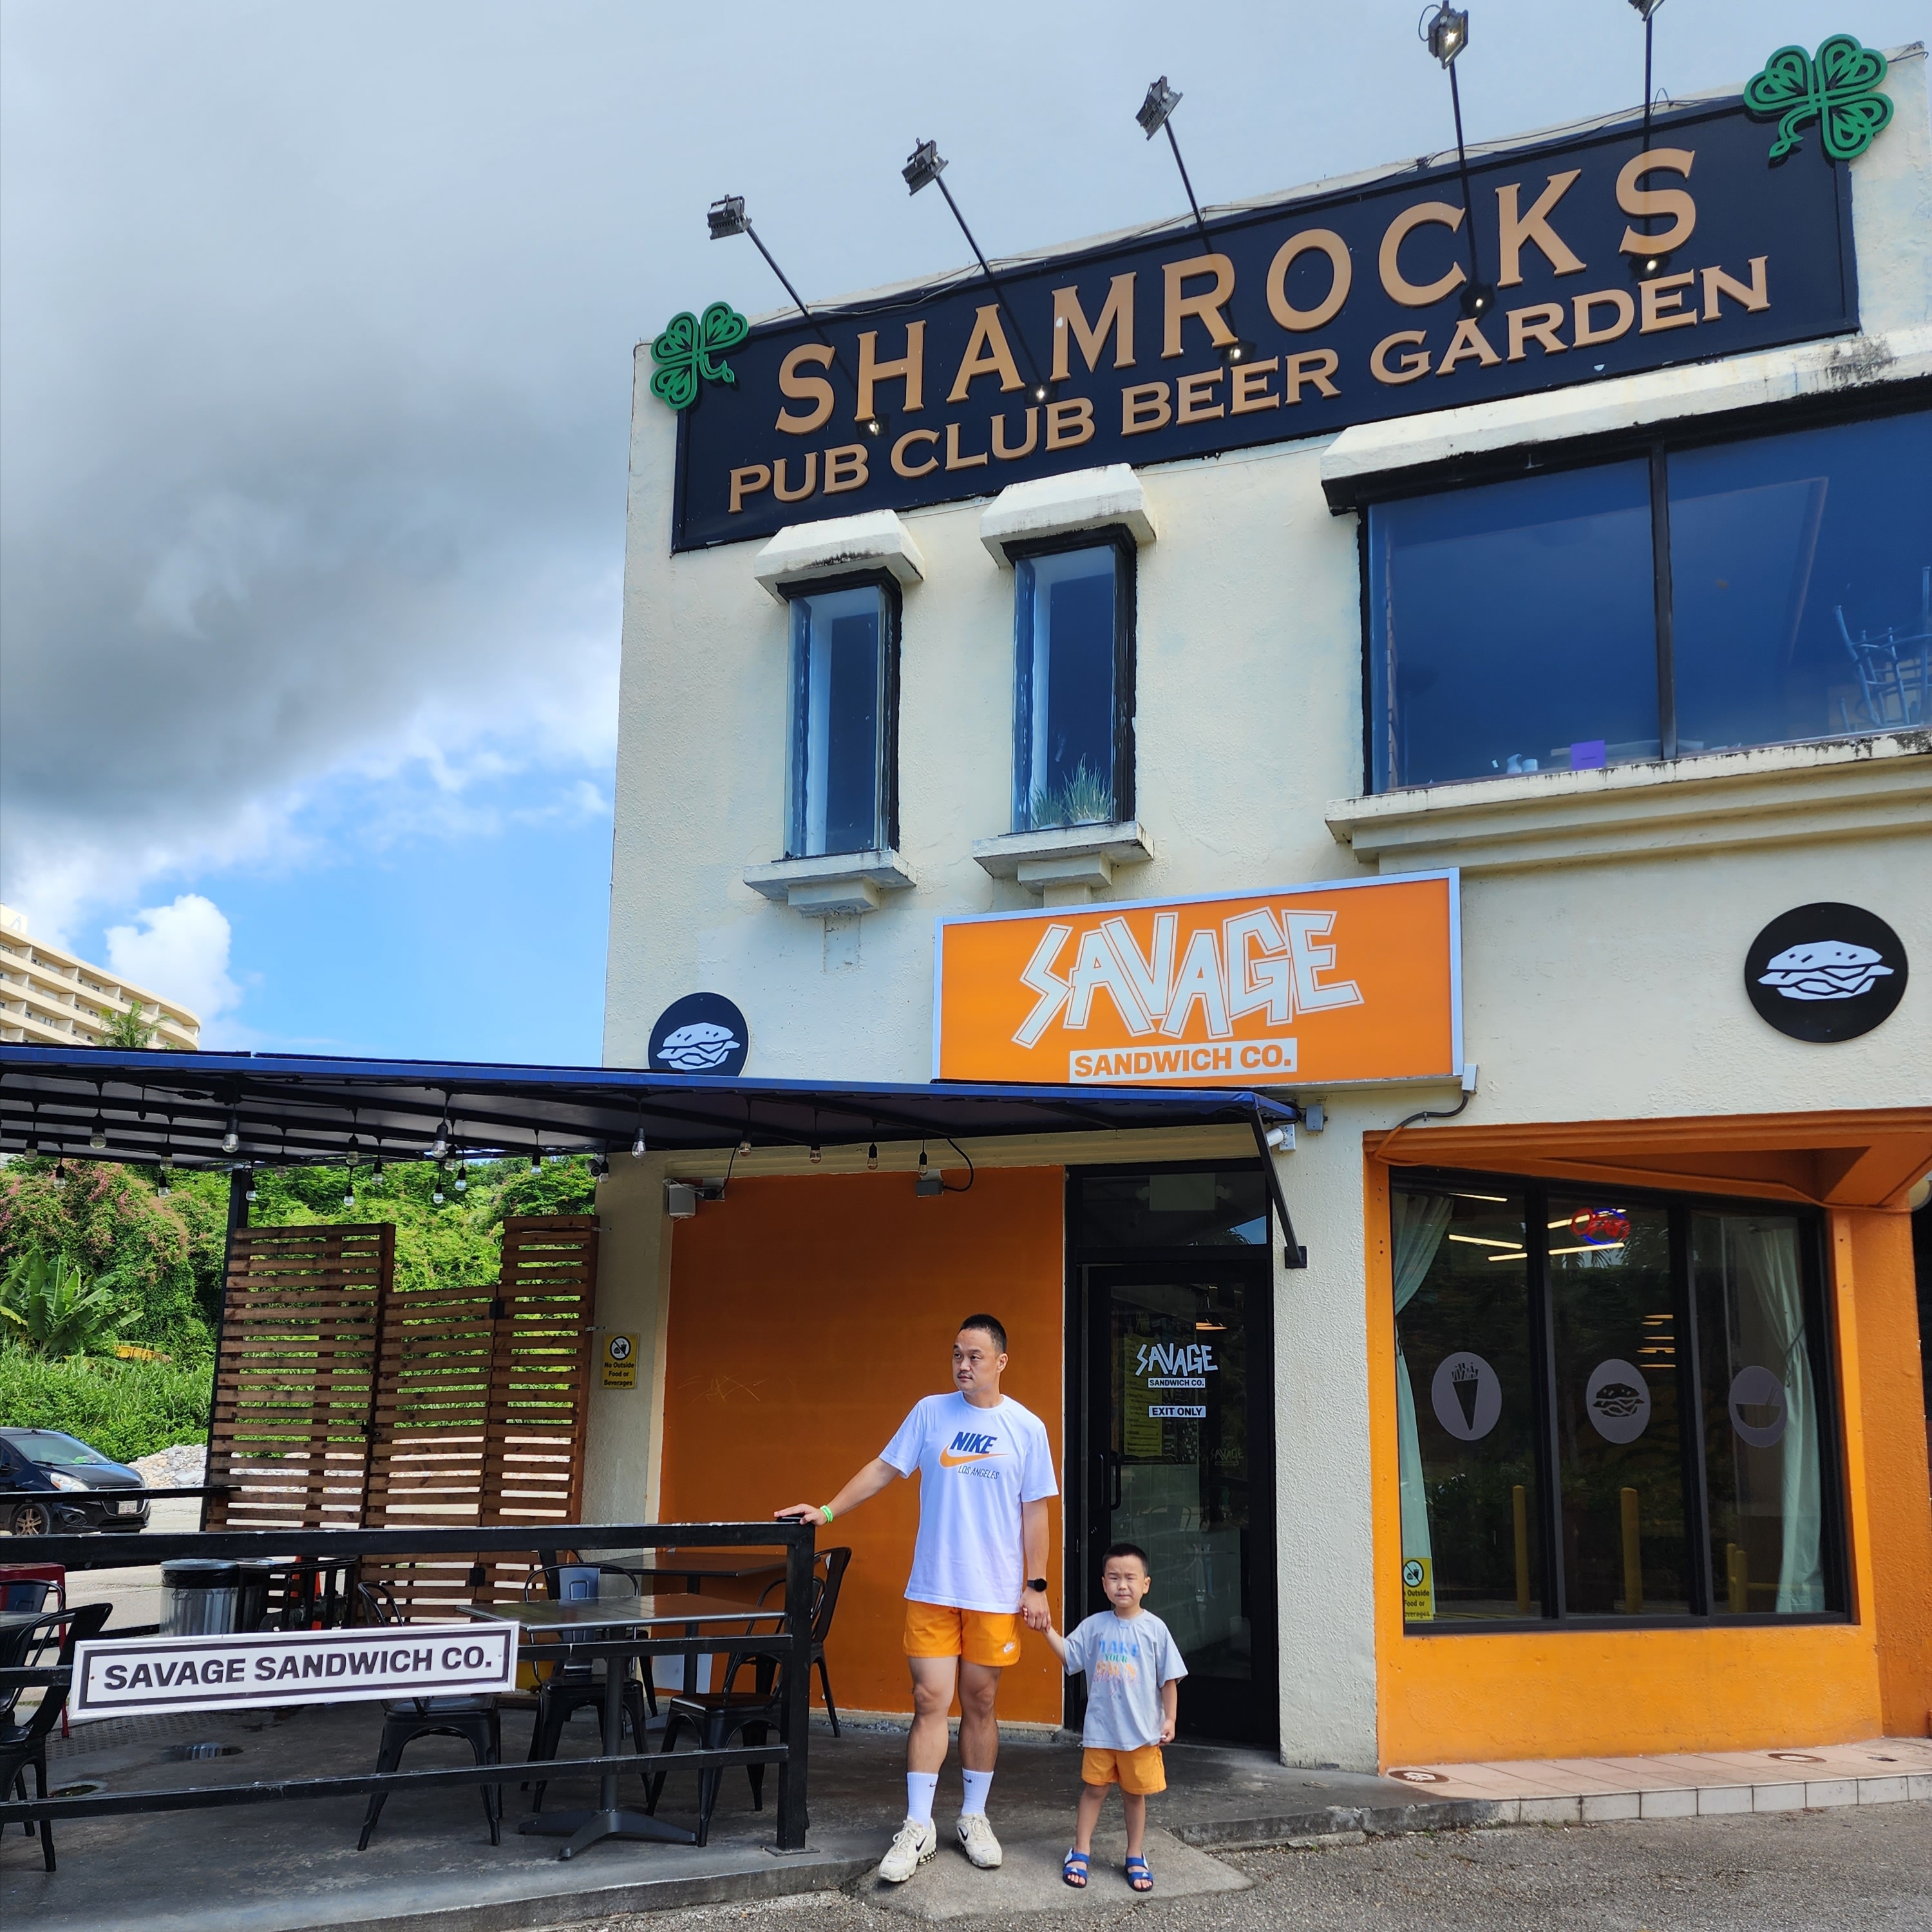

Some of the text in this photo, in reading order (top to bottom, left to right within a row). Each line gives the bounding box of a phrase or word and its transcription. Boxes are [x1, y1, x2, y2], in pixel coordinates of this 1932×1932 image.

[775, 147, 1696, 435] SHAMROCKS
[728, 255, 1770, 514] PUB CLUB BEER GARDEN
[1010, 905, 1365, 1050] SAVAGE
[1074, 1044, 1292, 1077] SANDWICH CO.
[1135, 1343, 1218, 1376] SAVAGE
[1151, 1407, 1202, 1416] EXIT ONLY
[950, 1432, 998, 1454] NIKE
[958, 1465, 999, 1480] LOS ANGELES
[104, 1646, 492, 1690] SAVAGE SANDWICH CO.
[1097, 1660, 1136, 1679] OWN
[1105, 1653, 1128, 1663] YOUR
